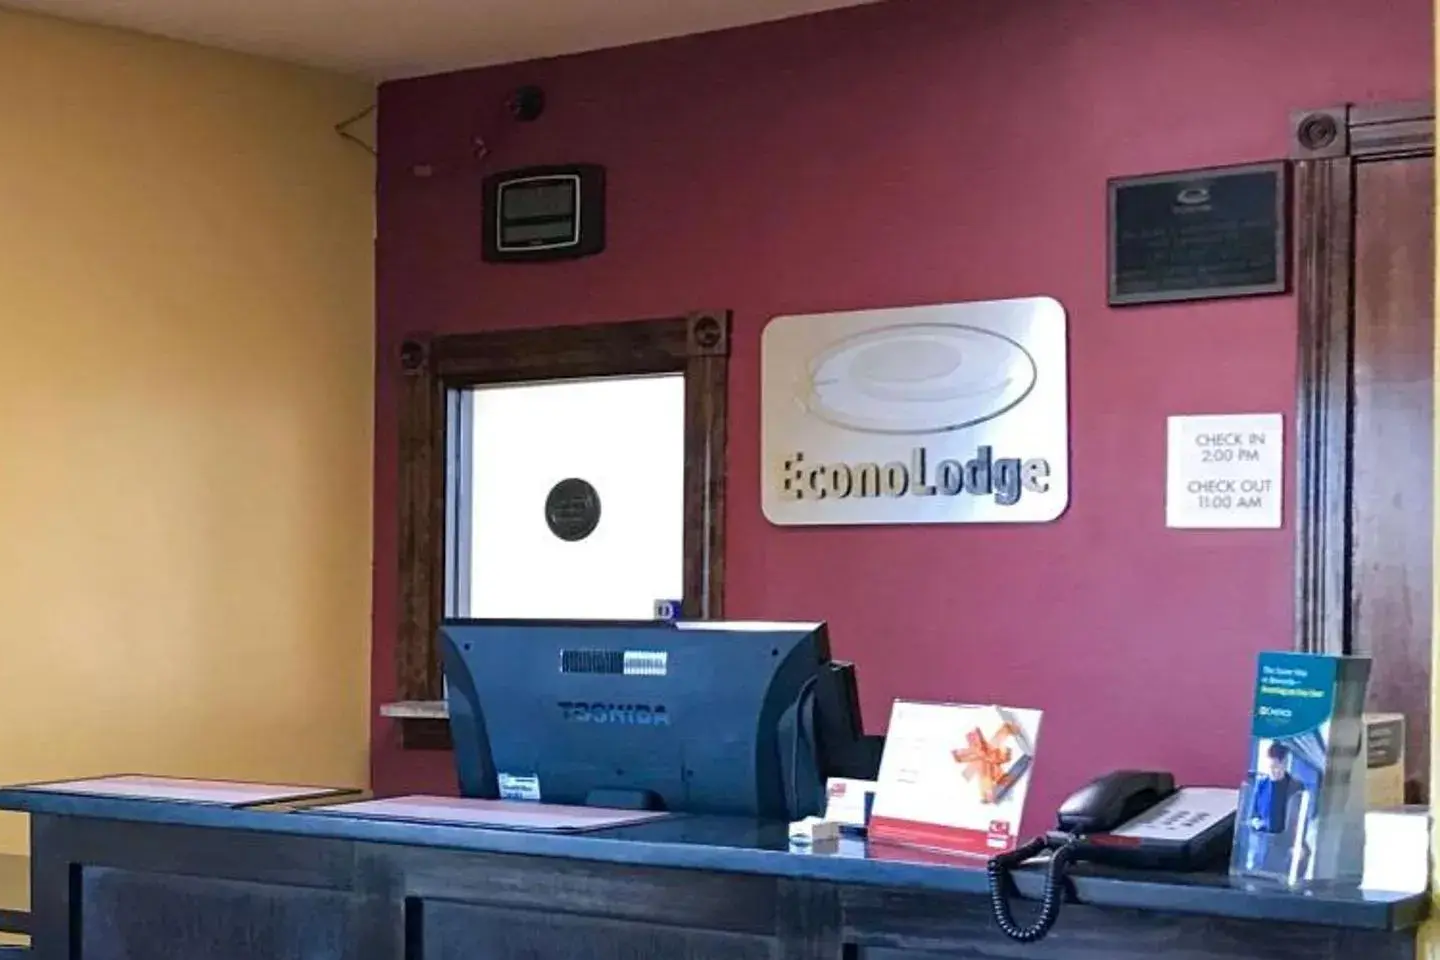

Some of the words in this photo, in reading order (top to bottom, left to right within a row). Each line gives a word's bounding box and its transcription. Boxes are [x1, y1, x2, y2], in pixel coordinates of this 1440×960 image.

[1195, 432, 1243, 447] CHECK
[1249, 432, 1267, 446] IN
[1201, 448, 1234, 462] 2:00
[1238, 448, 1261, 462] PM
[1187, 479, 1236, 494] CHECK
[1240, 479, 1273, 493] OUT
[1197, 495, 1232, 509] 11:00
[1236, 496, 1264, 508] AM
[558, 701, 670, 726] TOSHIBA
